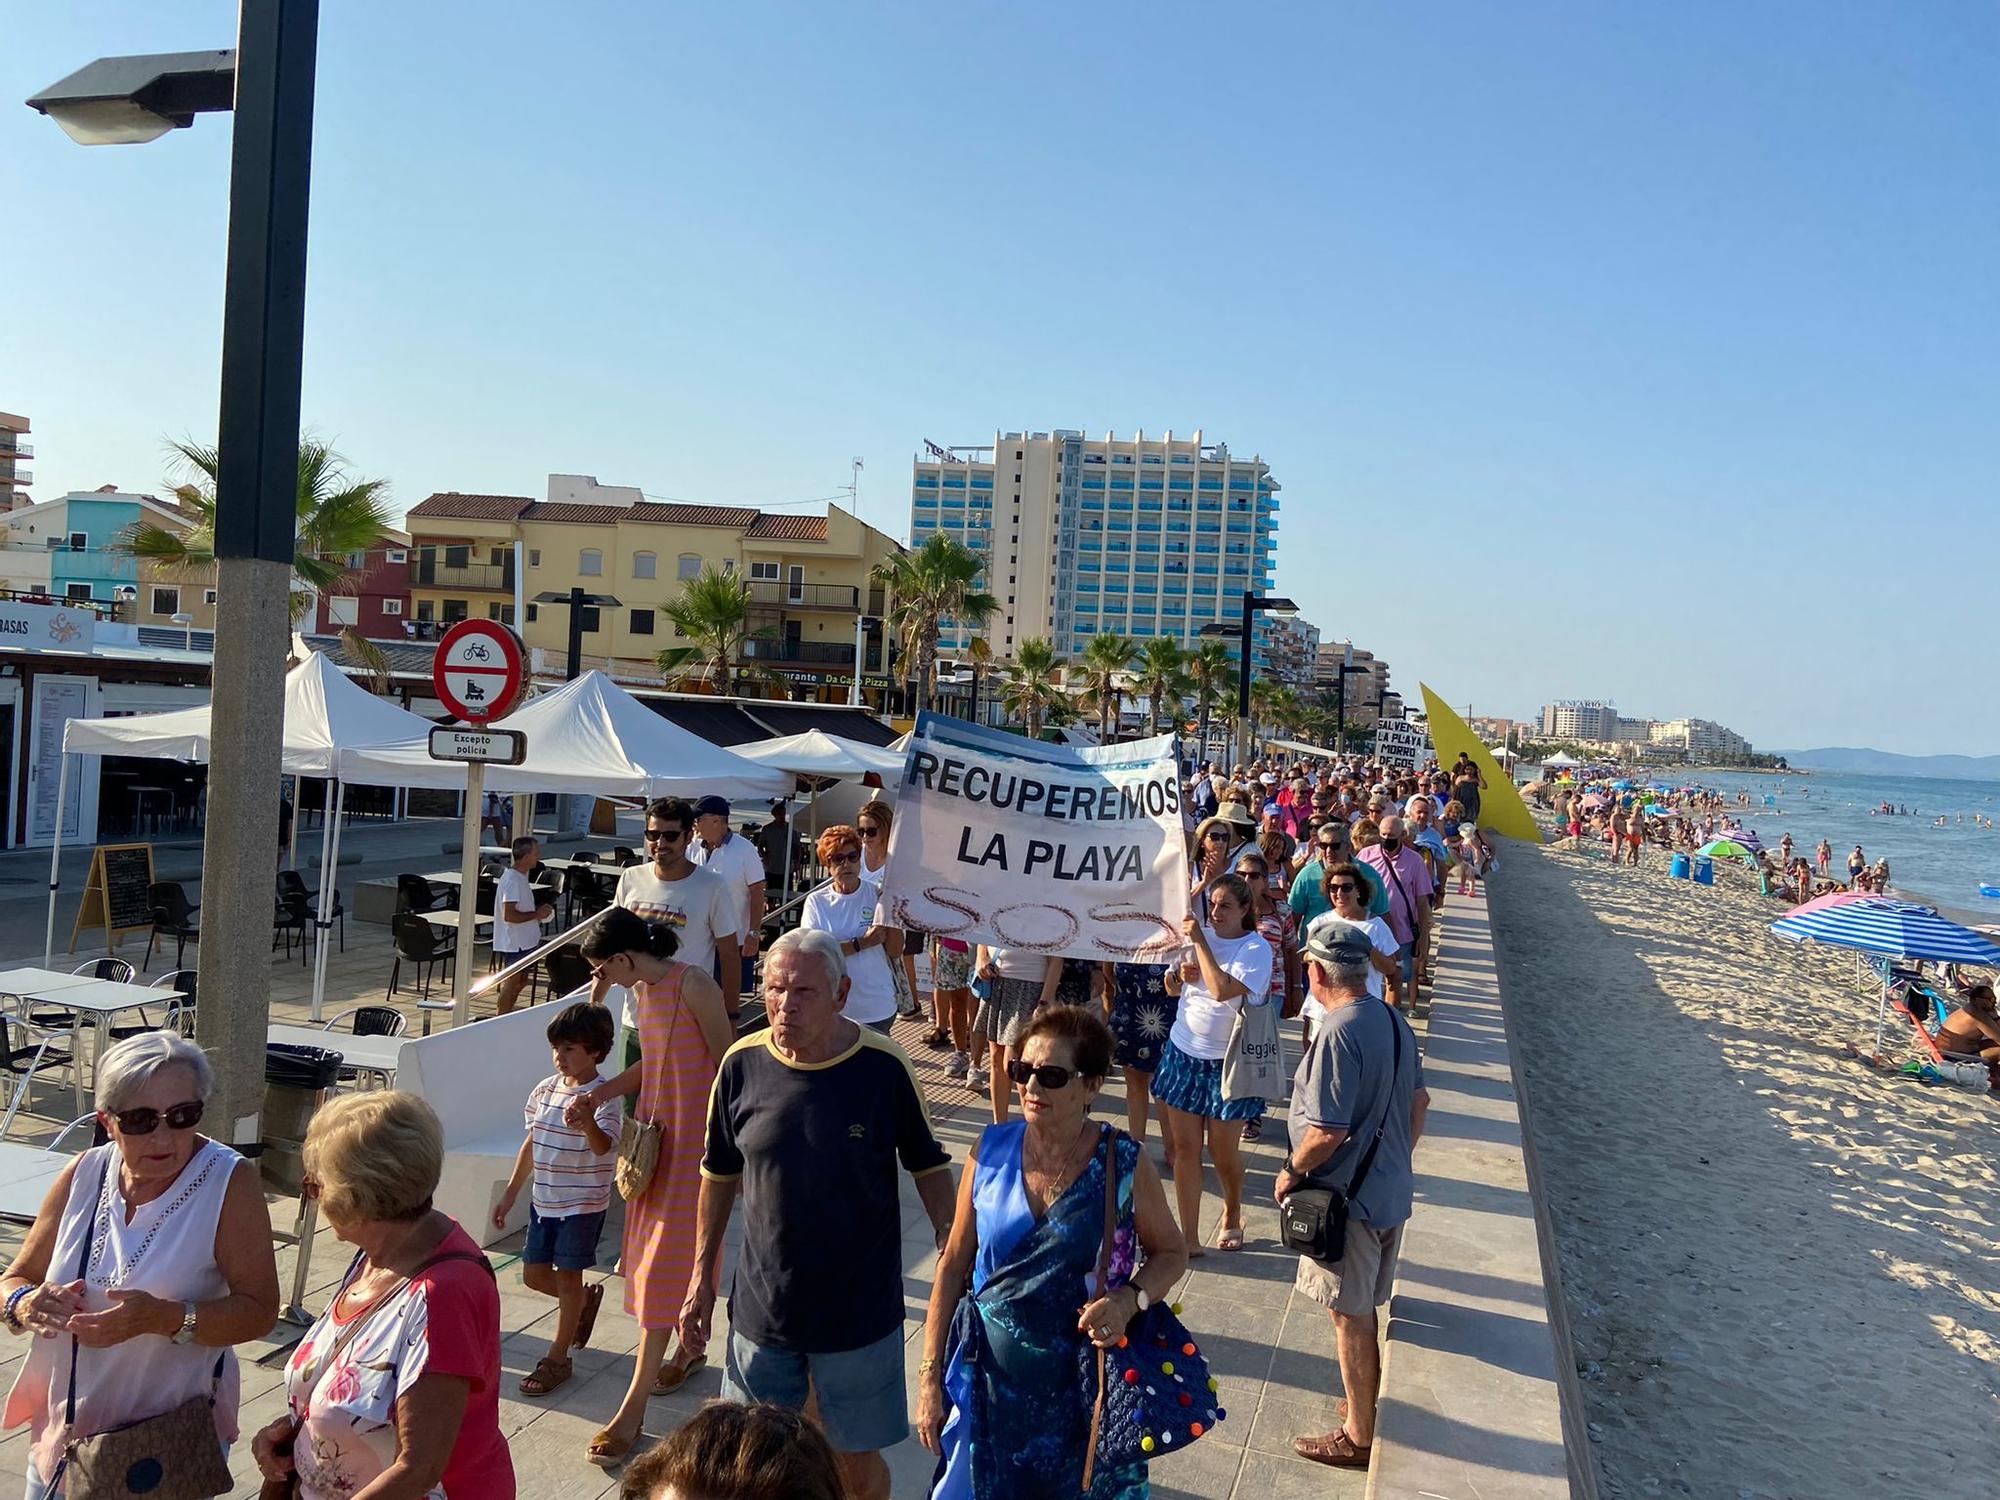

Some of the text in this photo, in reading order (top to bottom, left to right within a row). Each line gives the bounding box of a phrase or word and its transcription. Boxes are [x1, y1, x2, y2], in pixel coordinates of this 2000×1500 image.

[755, 672, 817, 682] Reurante
[864, 677, 889, 687] Pizza
[1377, 720, 1425, 735] SALVEMOS
[454, 734, 491, 745] Excepto
[1378, 731, 1421, 747] LA PLAYA
[1380, 744, 1416, 757] MORRO
[1379, 756, 1415, 769] DE GOS
[908, 751, 1179, 820] RECUPEREMOS
[957, 826, 1143, 882] LA PLAYA
[892, 886, 1184, 956] SOS
